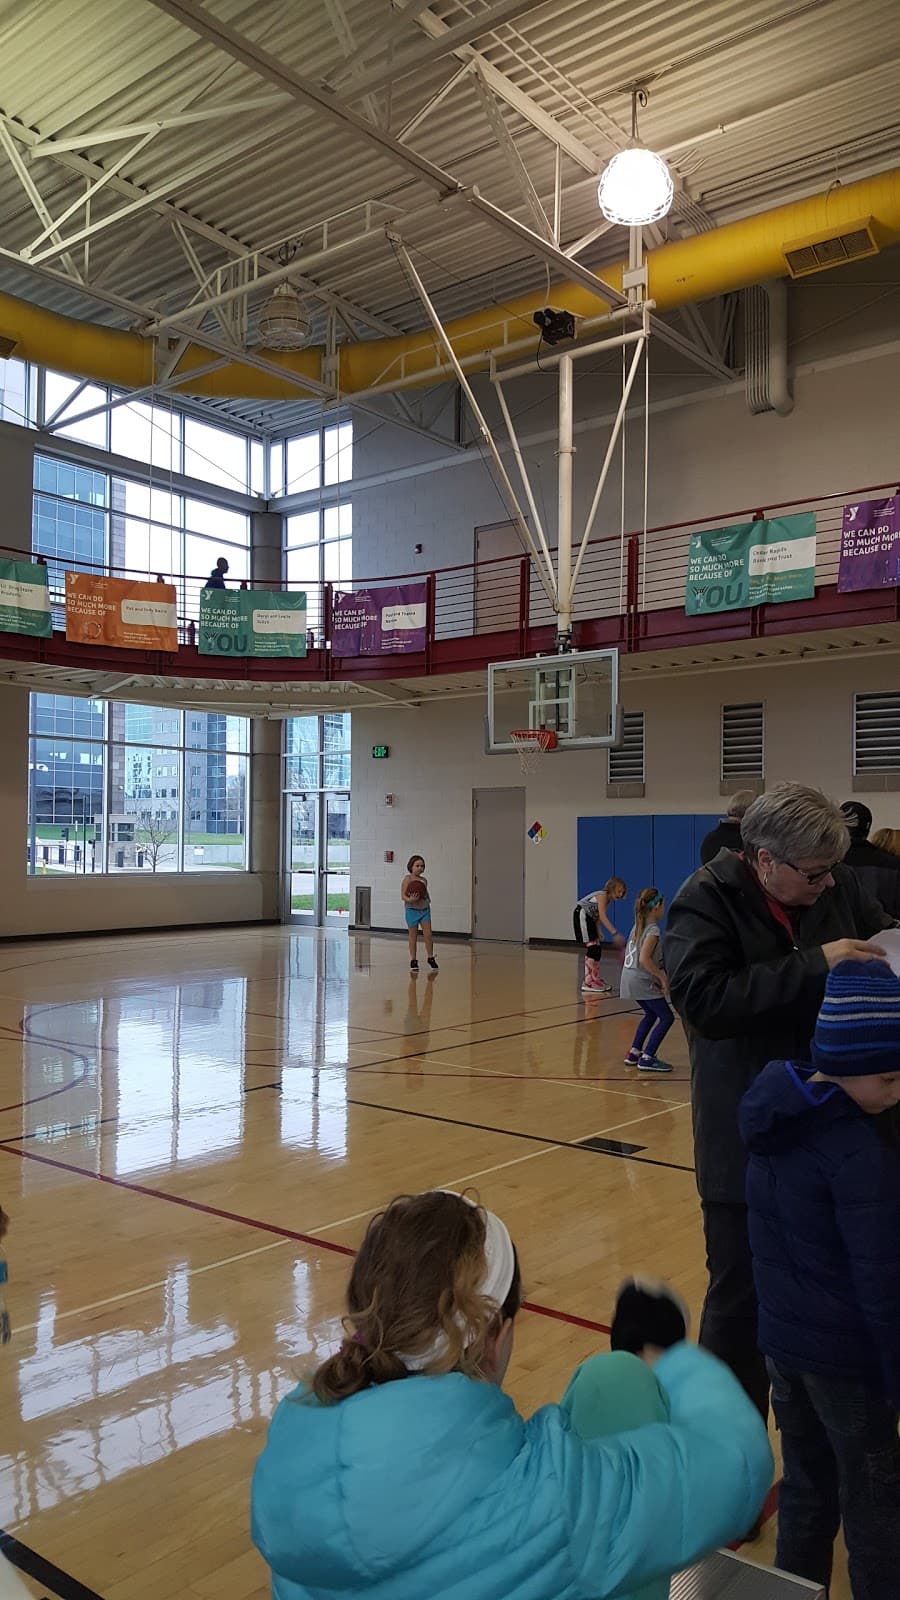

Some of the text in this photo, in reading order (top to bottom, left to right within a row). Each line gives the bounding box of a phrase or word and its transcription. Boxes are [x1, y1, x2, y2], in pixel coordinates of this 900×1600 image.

[843, 525, 889, 539] WE CAN DO
[843, 540, 854, 548] SO
[856, 535, 880, 546] MUCH
[843, 543, 893, 557] BECAUSE OF
[689, 559, 745, 573] SO MUCH MORE
[690, 557, 701, 565] WE
[703, 555, 718, 564] CAN
[688, 570, 733, 581] BECAUSE OF
[79, 593, 92, 601] CAN
[67, 606, 96, 616] BECAUSE
[77, 600, 97, 608] MUCH
[98, 603, 116, 612] MORE
